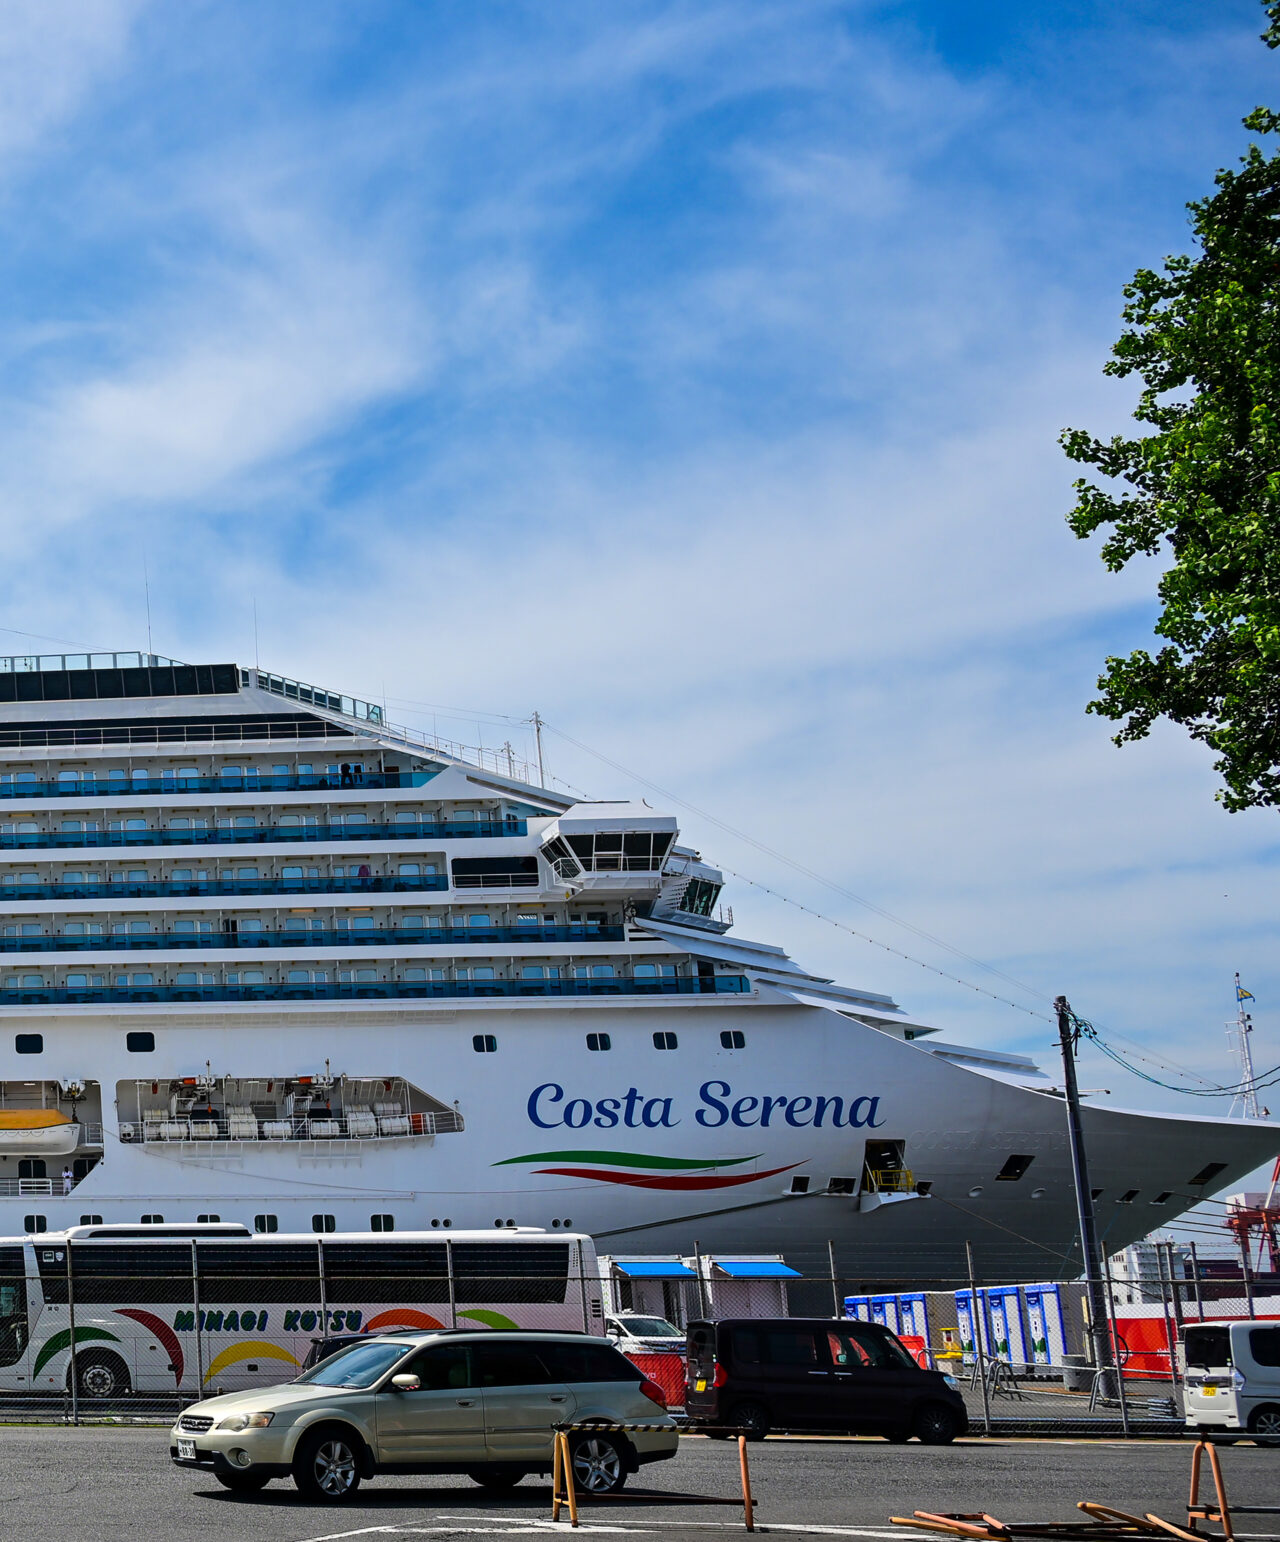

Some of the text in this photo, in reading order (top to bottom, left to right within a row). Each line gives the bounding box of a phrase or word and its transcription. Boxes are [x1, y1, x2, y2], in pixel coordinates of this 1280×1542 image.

[527, 1080, 886, 1128] Costa Serena
[173, 1309, 363, 1332] MINAGI KOTSU
